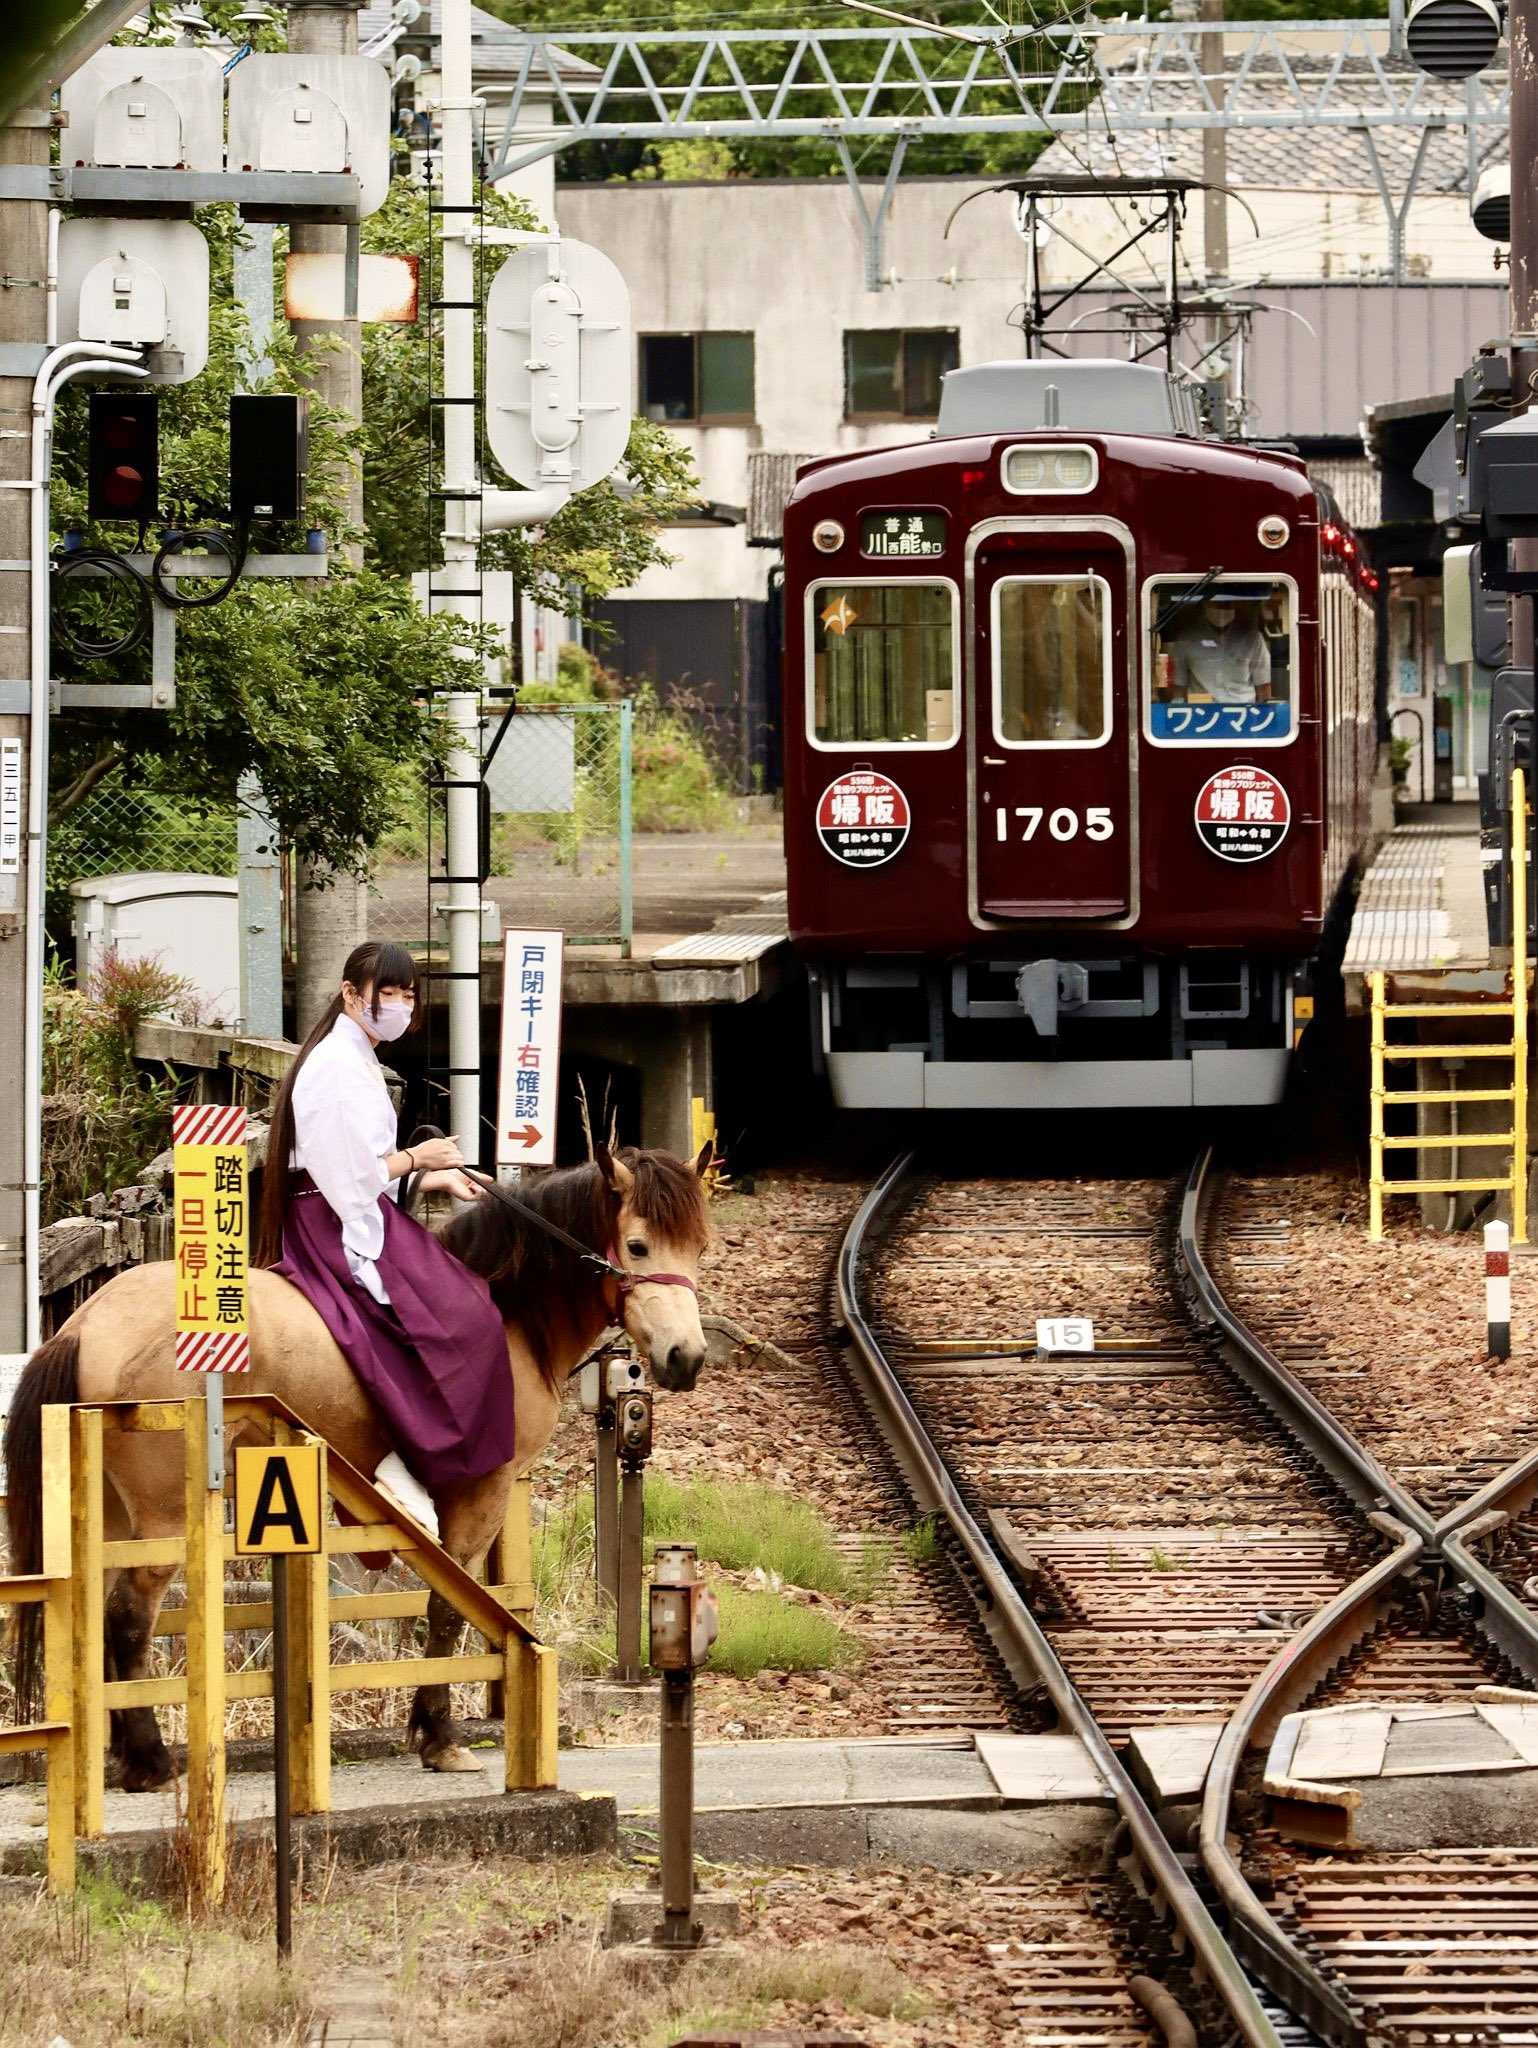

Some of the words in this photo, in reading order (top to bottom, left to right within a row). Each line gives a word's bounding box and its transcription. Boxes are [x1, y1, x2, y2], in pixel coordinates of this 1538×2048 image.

[884, 516, 925, 533] 普通
[866, 532, 942, 555] 川西能勢口
[1166, 706, 1275, 733] ワンマン
[831, 794, 895, 825] 帰阪
[1210, 789, 1275, 821] 帰阪
[996, 807, 1114, 841] 1705
[514, 945, 546, 1119] 戸閉キー右確認
[178, 1171, 208, 1322] 一旦停止
[214, 1154, 245, 1325] 踏切注意
[1046, 1325, 1083, 1345] 15
[246, 1456, 309, 1545] A
